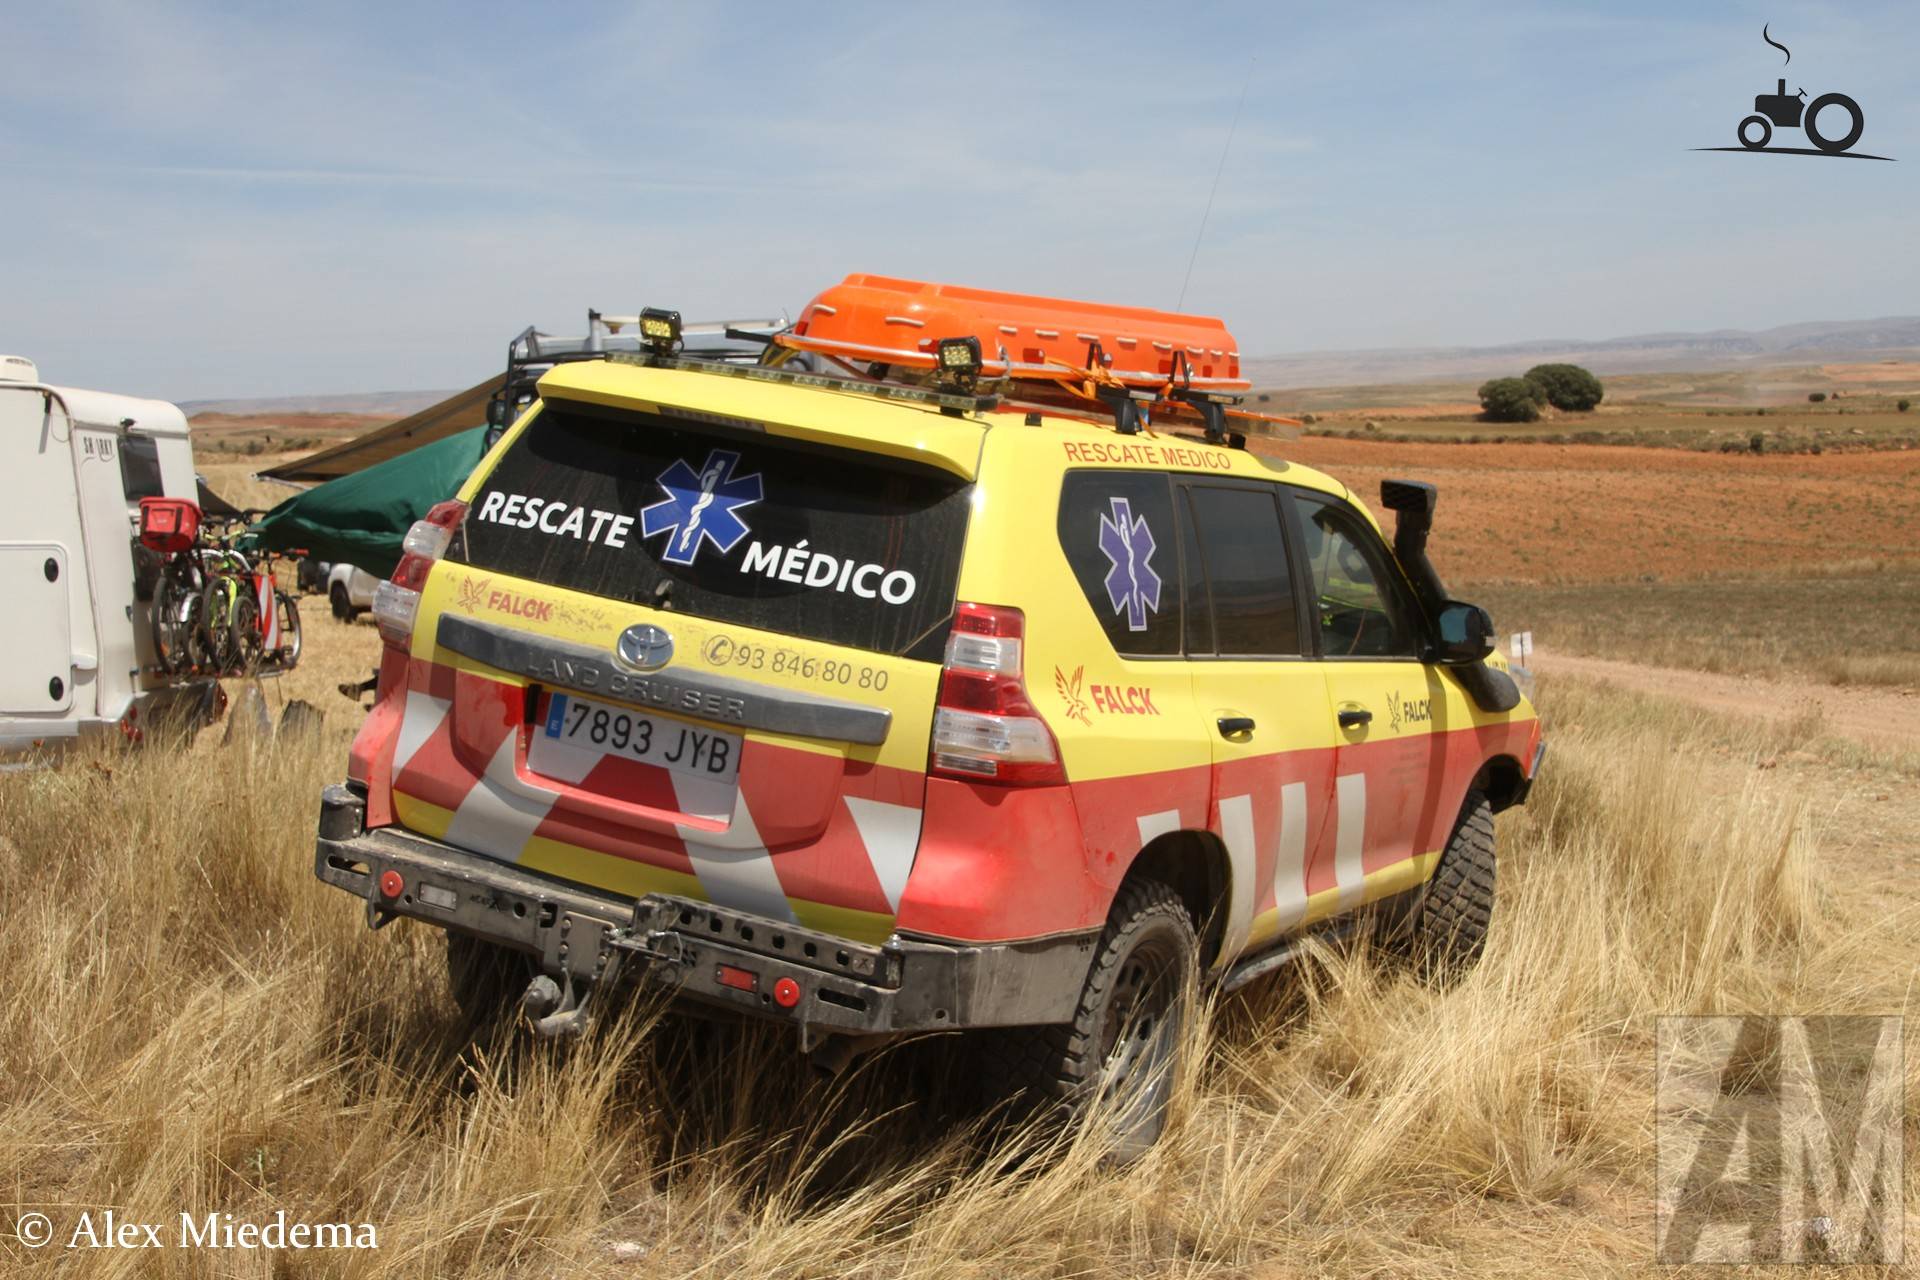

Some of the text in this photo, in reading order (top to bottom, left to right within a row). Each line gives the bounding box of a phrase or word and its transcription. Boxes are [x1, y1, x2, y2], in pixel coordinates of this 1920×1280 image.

[1063, 442, 1231, 470] RESCATE MEDICO
[478, 490, 635, 549] RESCATE
[740, 540, 916, 605] MÉDICO
[487, 590, 552, 622] FALCK
[527, 651, 745, 721] LAND CRUISER
[737, 646, 889, 692] 93 846 80 80
[1090, 684, 1160, 717] FALCK
[1403, 699, 1432, 723] FALCK
[568, 703, 730, 774] 7893 JYB
